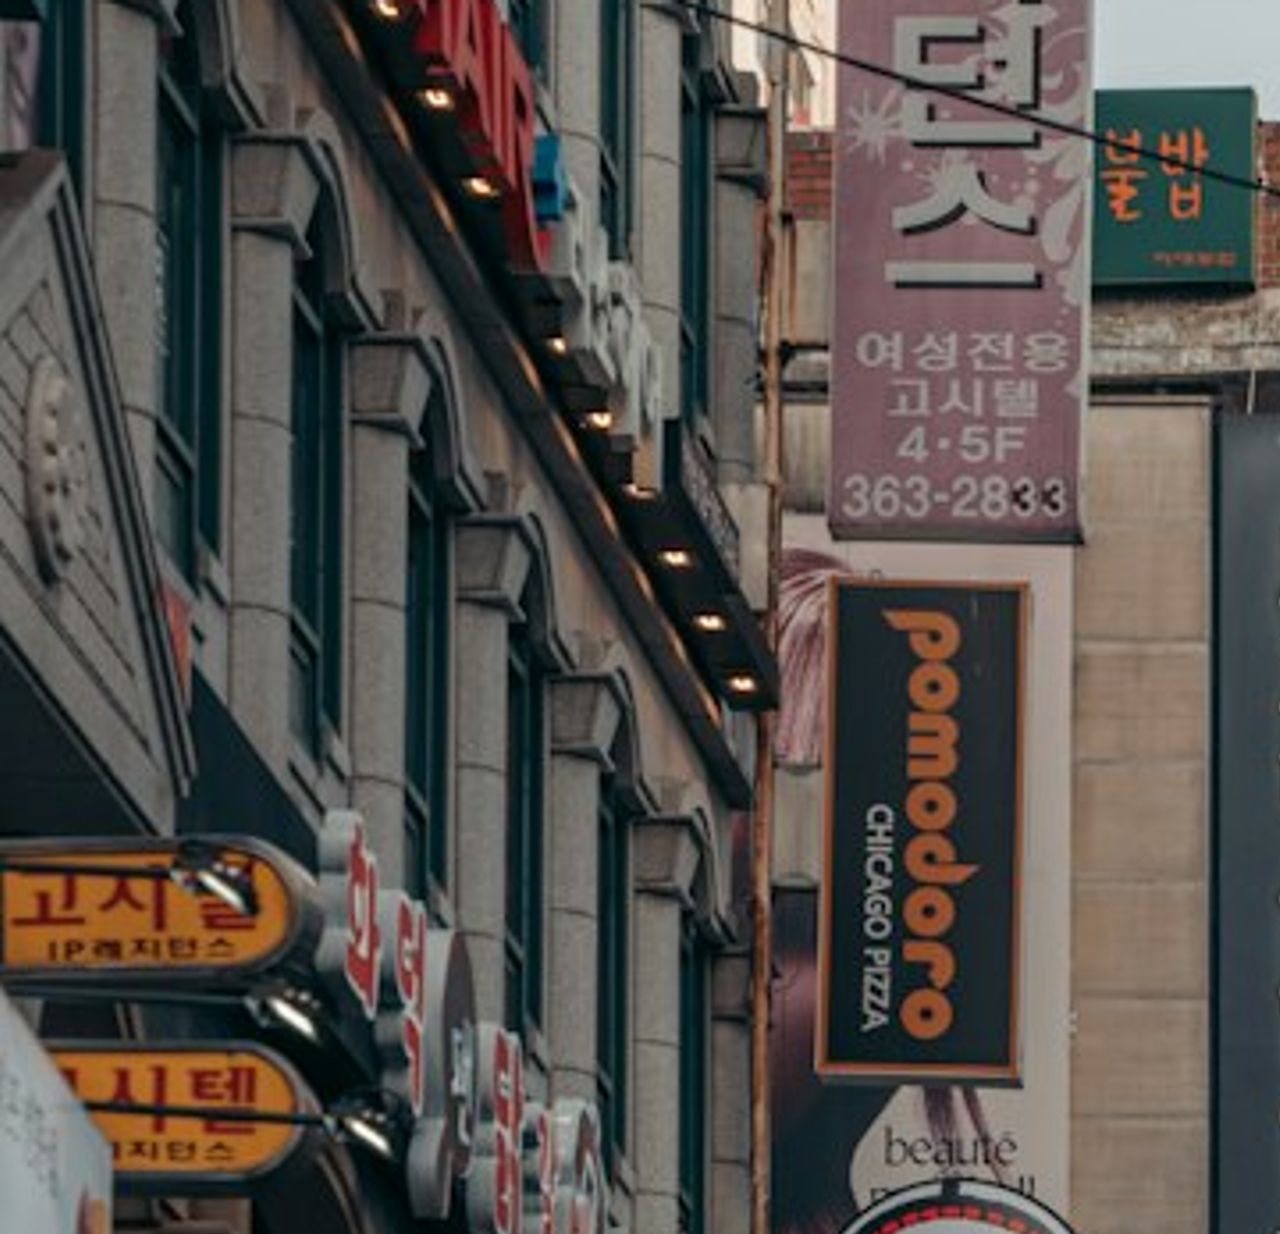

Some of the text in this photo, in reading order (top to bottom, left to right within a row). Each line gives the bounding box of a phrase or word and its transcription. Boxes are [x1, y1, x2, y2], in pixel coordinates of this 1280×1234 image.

[855, 329, 1070, 374] 여성전용
[886, 377, 1040, 419] 고시텔
[843, 474, 1068, 520] 363-2833
[881, 609, 981, 1040] pomodoro
[860, 803, 893, 1032] CHICAGO PIZZA
[60, 1065, 258, 1135] 시텔
